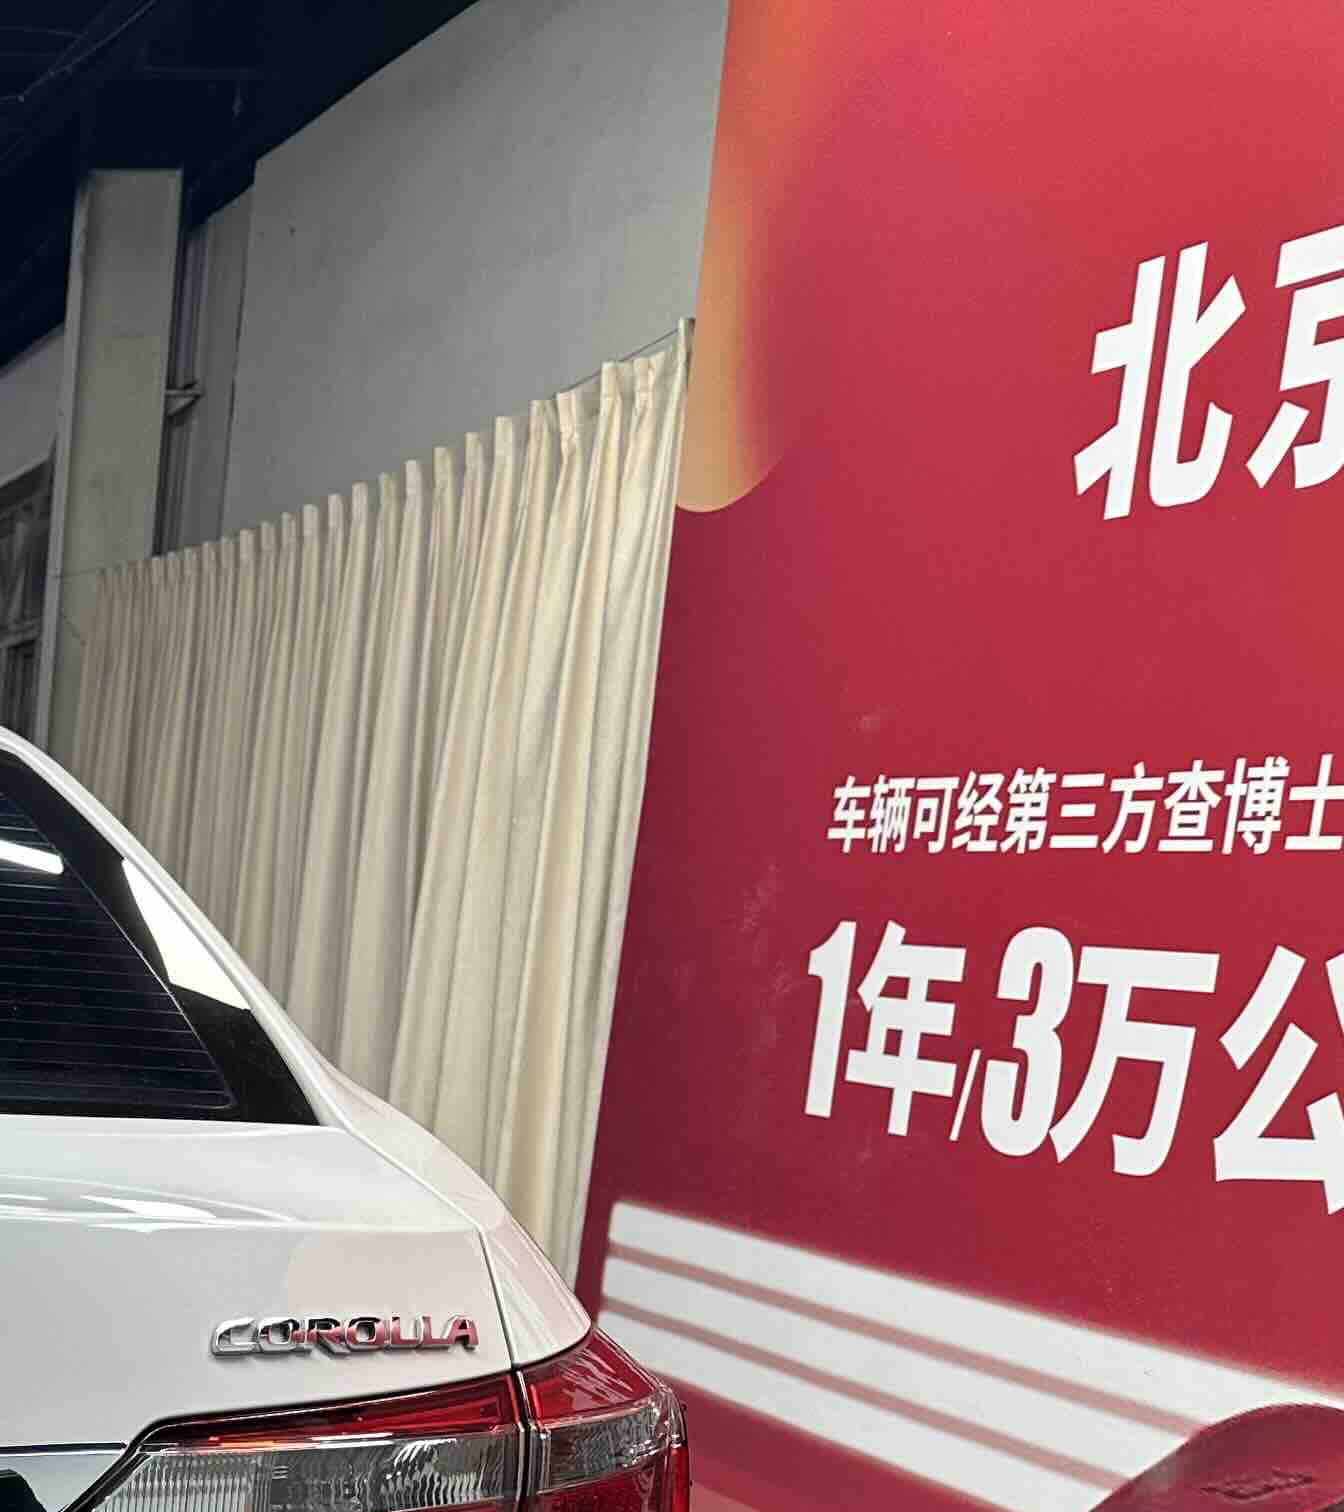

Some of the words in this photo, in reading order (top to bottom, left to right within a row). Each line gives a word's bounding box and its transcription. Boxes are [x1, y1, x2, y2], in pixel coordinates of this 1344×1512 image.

[827, 753, 1344, 855] 车辆可经第三方查博士
[211, 1312, 480, 1357] COROLLA
